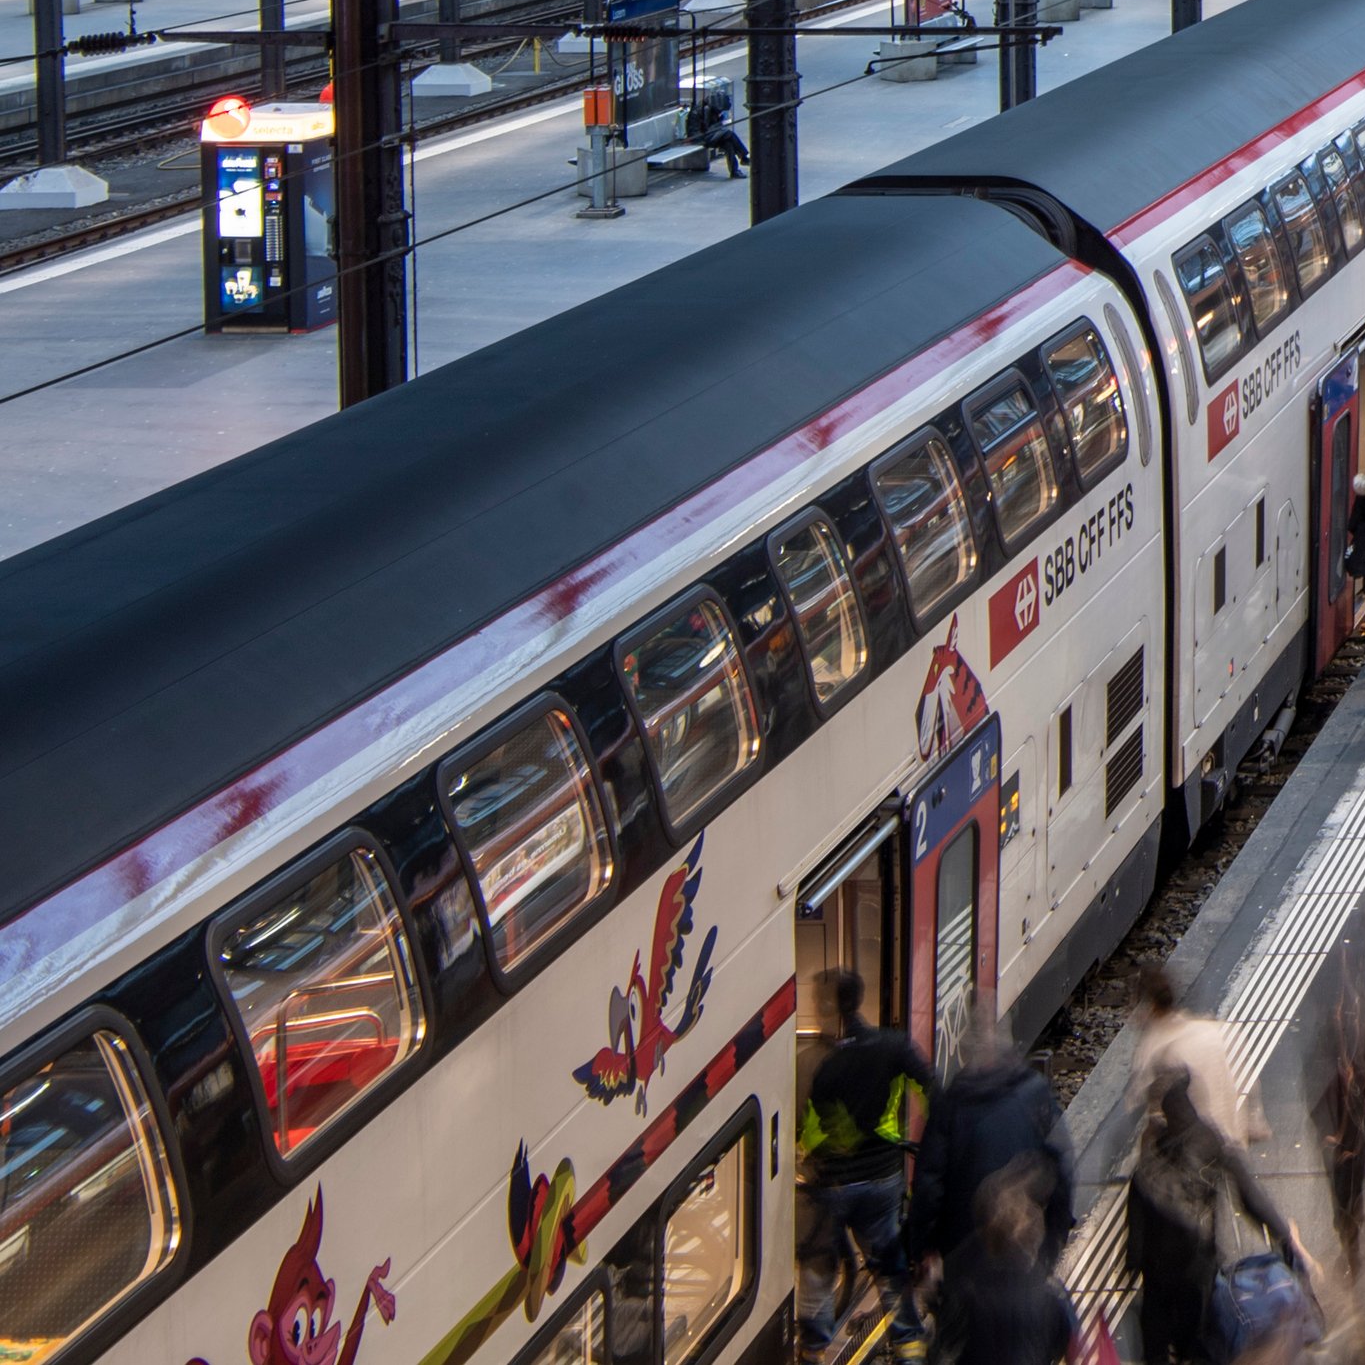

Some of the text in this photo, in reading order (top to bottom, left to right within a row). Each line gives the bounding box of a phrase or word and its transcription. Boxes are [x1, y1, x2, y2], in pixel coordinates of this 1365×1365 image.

[1242, 329, 1300, 419] SBB CFF FFS
[1044, 483, 1134, 607] SBB CFF FFS
[916, 801, 928, 860] 2
